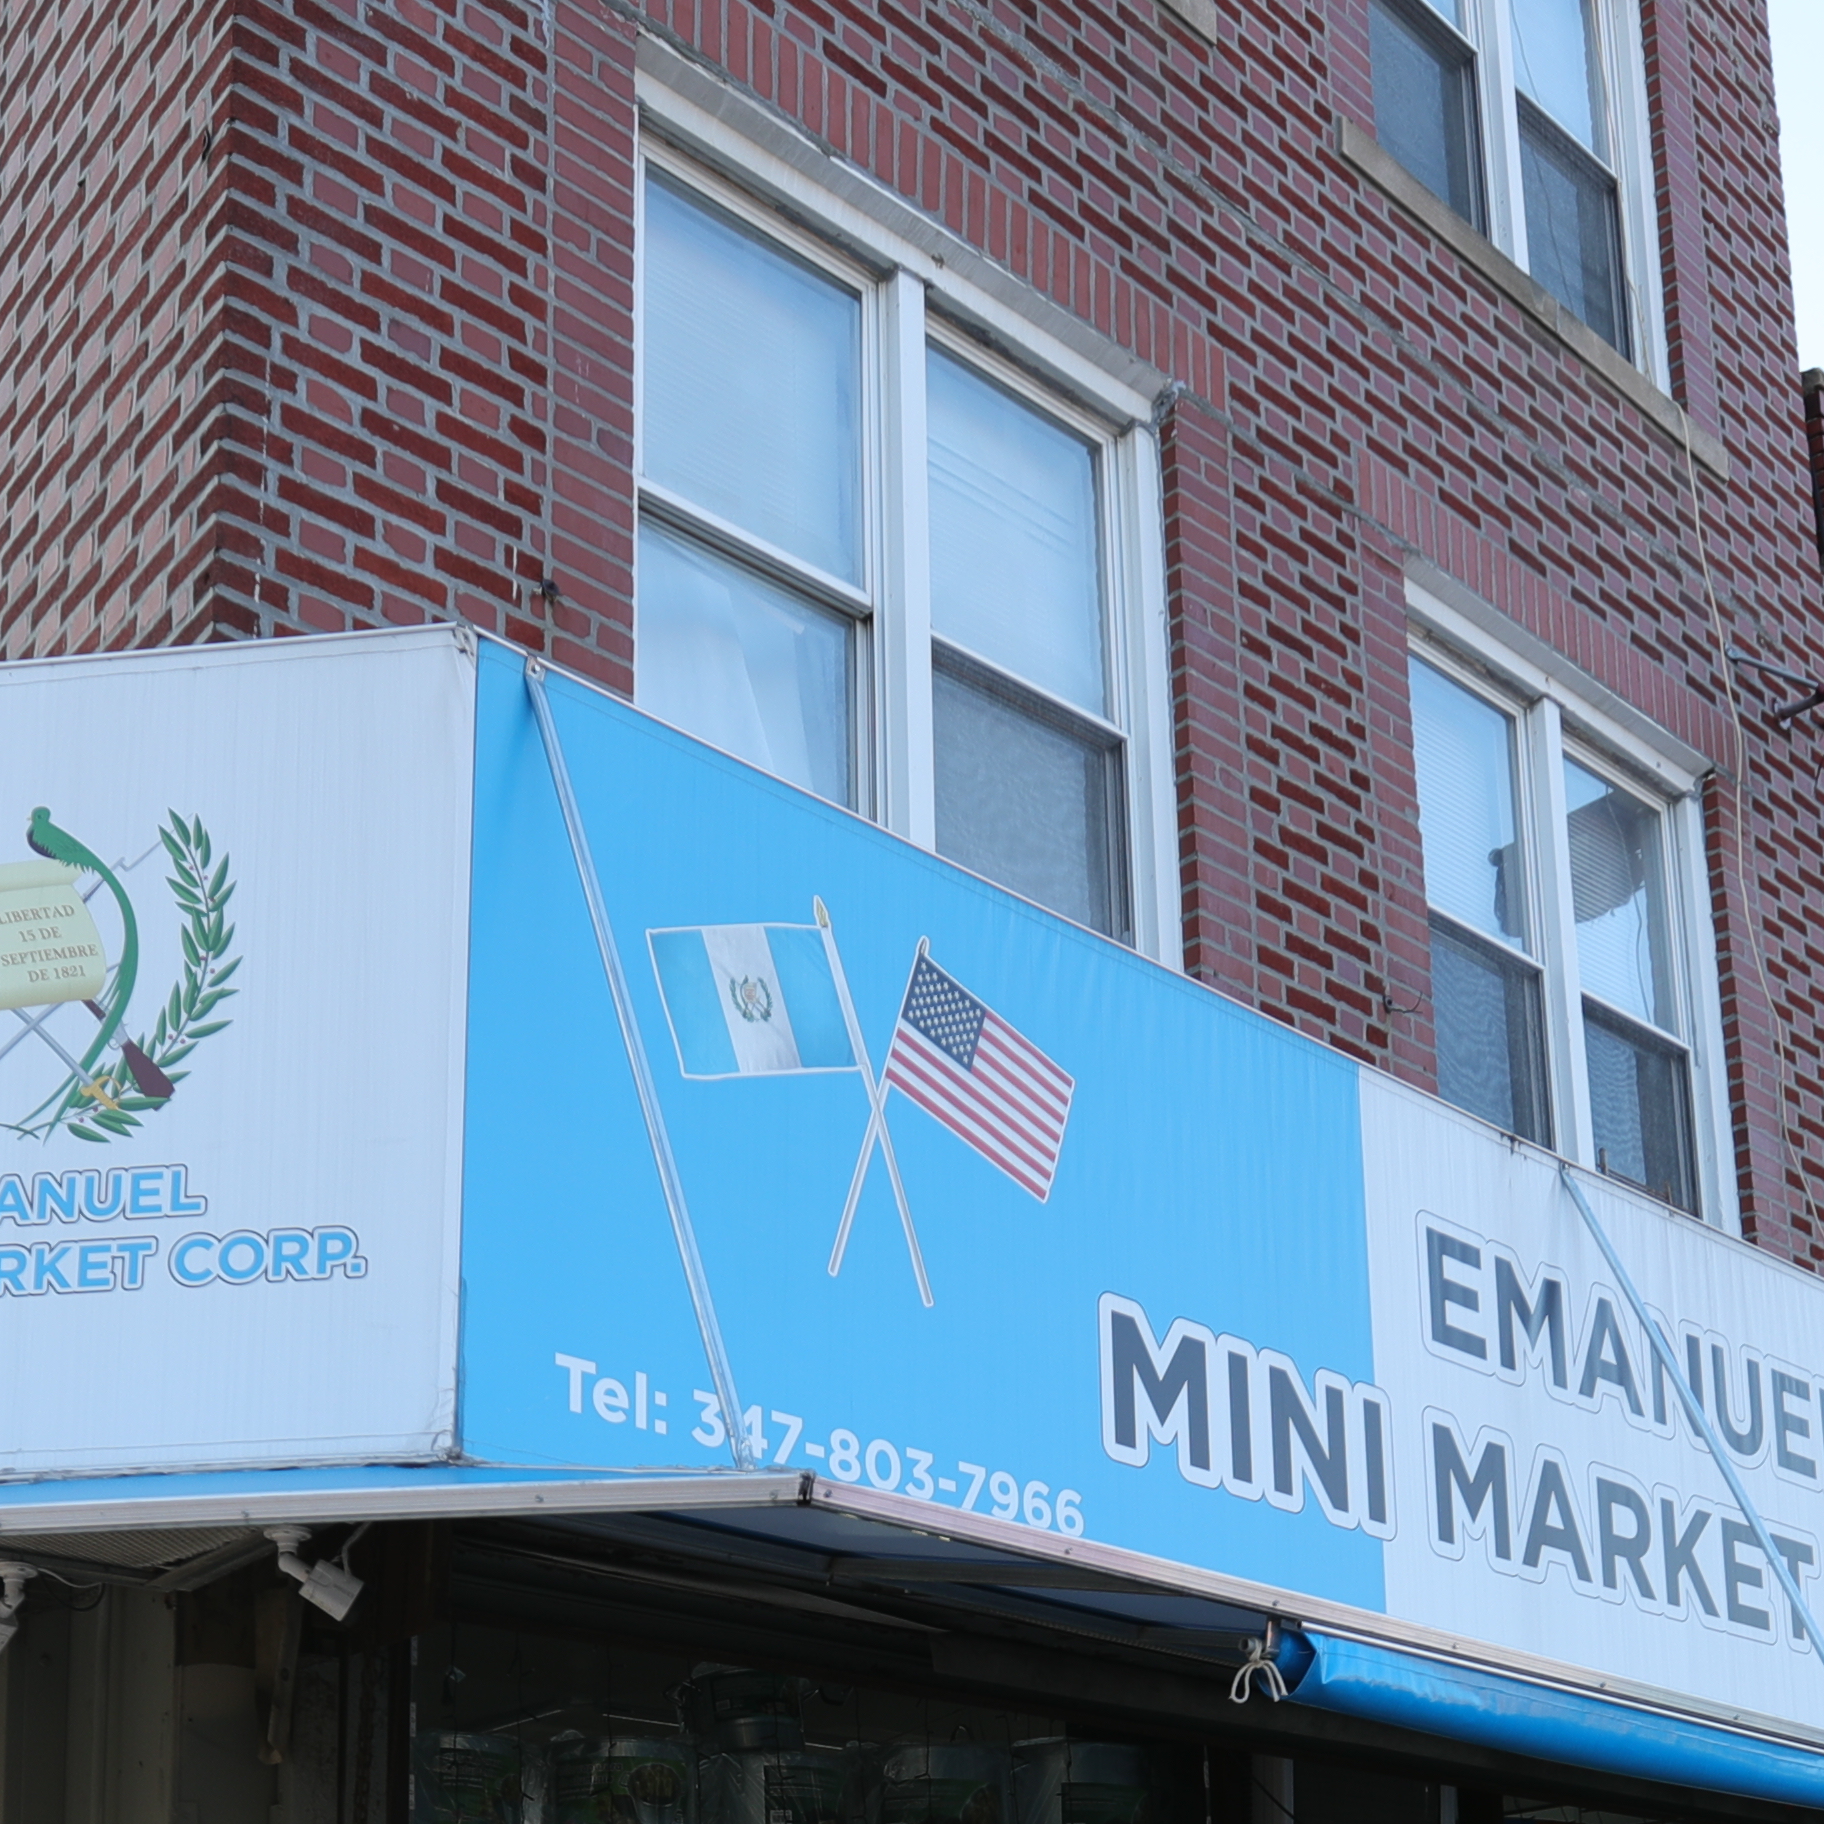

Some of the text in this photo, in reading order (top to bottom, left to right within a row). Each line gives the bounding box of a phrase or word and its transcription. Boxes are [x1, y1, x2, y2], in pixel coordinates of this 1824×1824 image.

[19, 926, 62, 942] 15 DE
[0, 944, 98, 967] SEPTIEMBRE
[27, 965, 86, 983] DE 1821
[170, 1227, 366, 1287] CORP.
[555, 1353, 669, 1435] Tel:
[1104, 1302, 1392, 1533] MINI
[1426, 1414, 1820, 1655] MARKET
